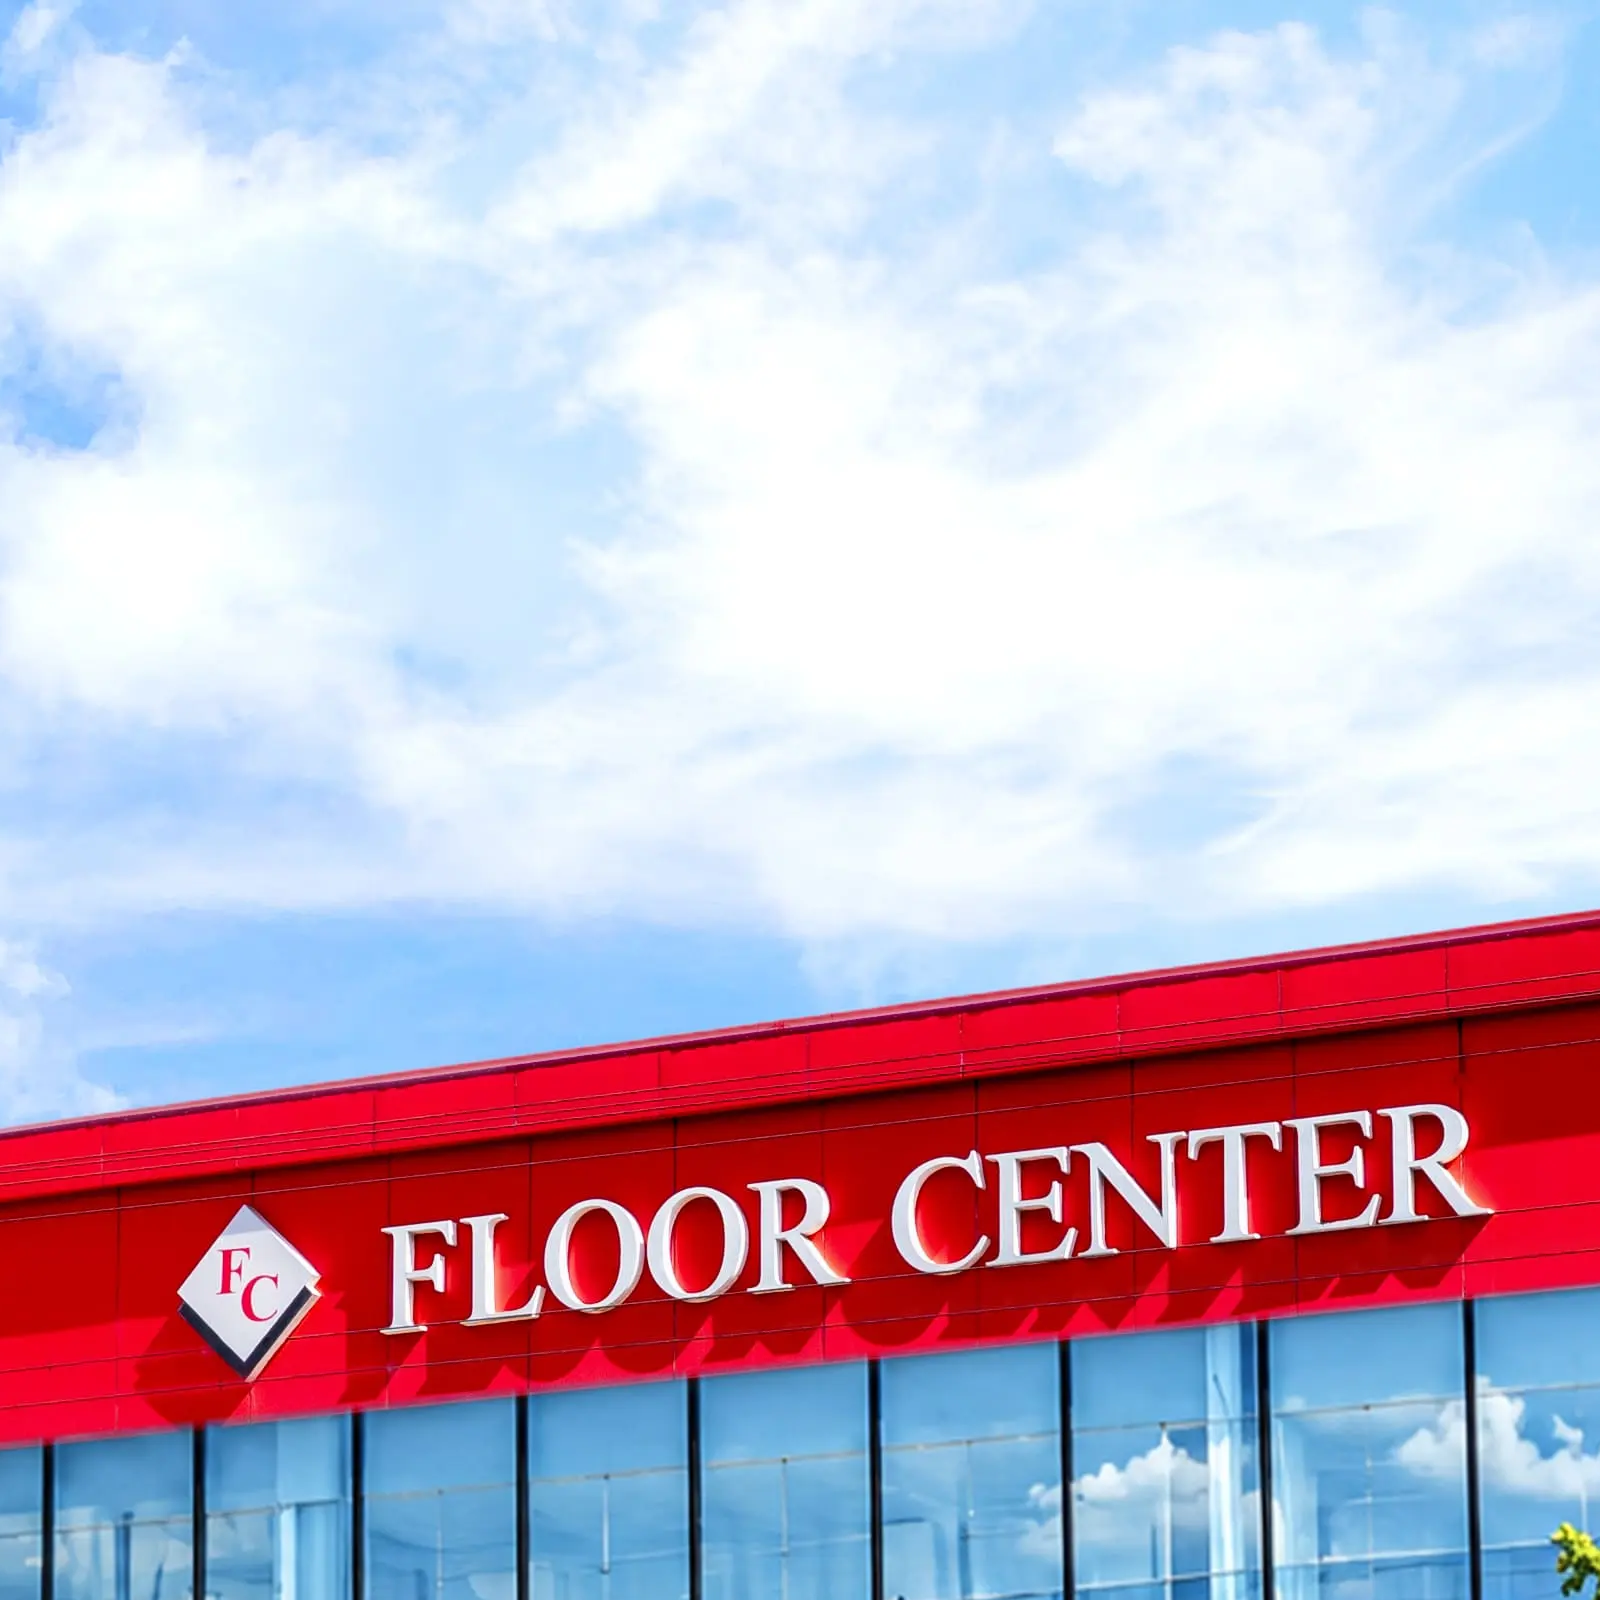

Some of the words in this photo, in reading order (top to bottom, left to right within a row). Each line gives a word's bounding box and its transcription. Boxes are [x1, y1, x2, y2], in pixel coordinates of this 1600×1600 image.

[216, 1246, 280, 1323] FC
[379, 1177, 853, 1336] FLOOR
[890, 1103, 1496, 1275] CENTER
